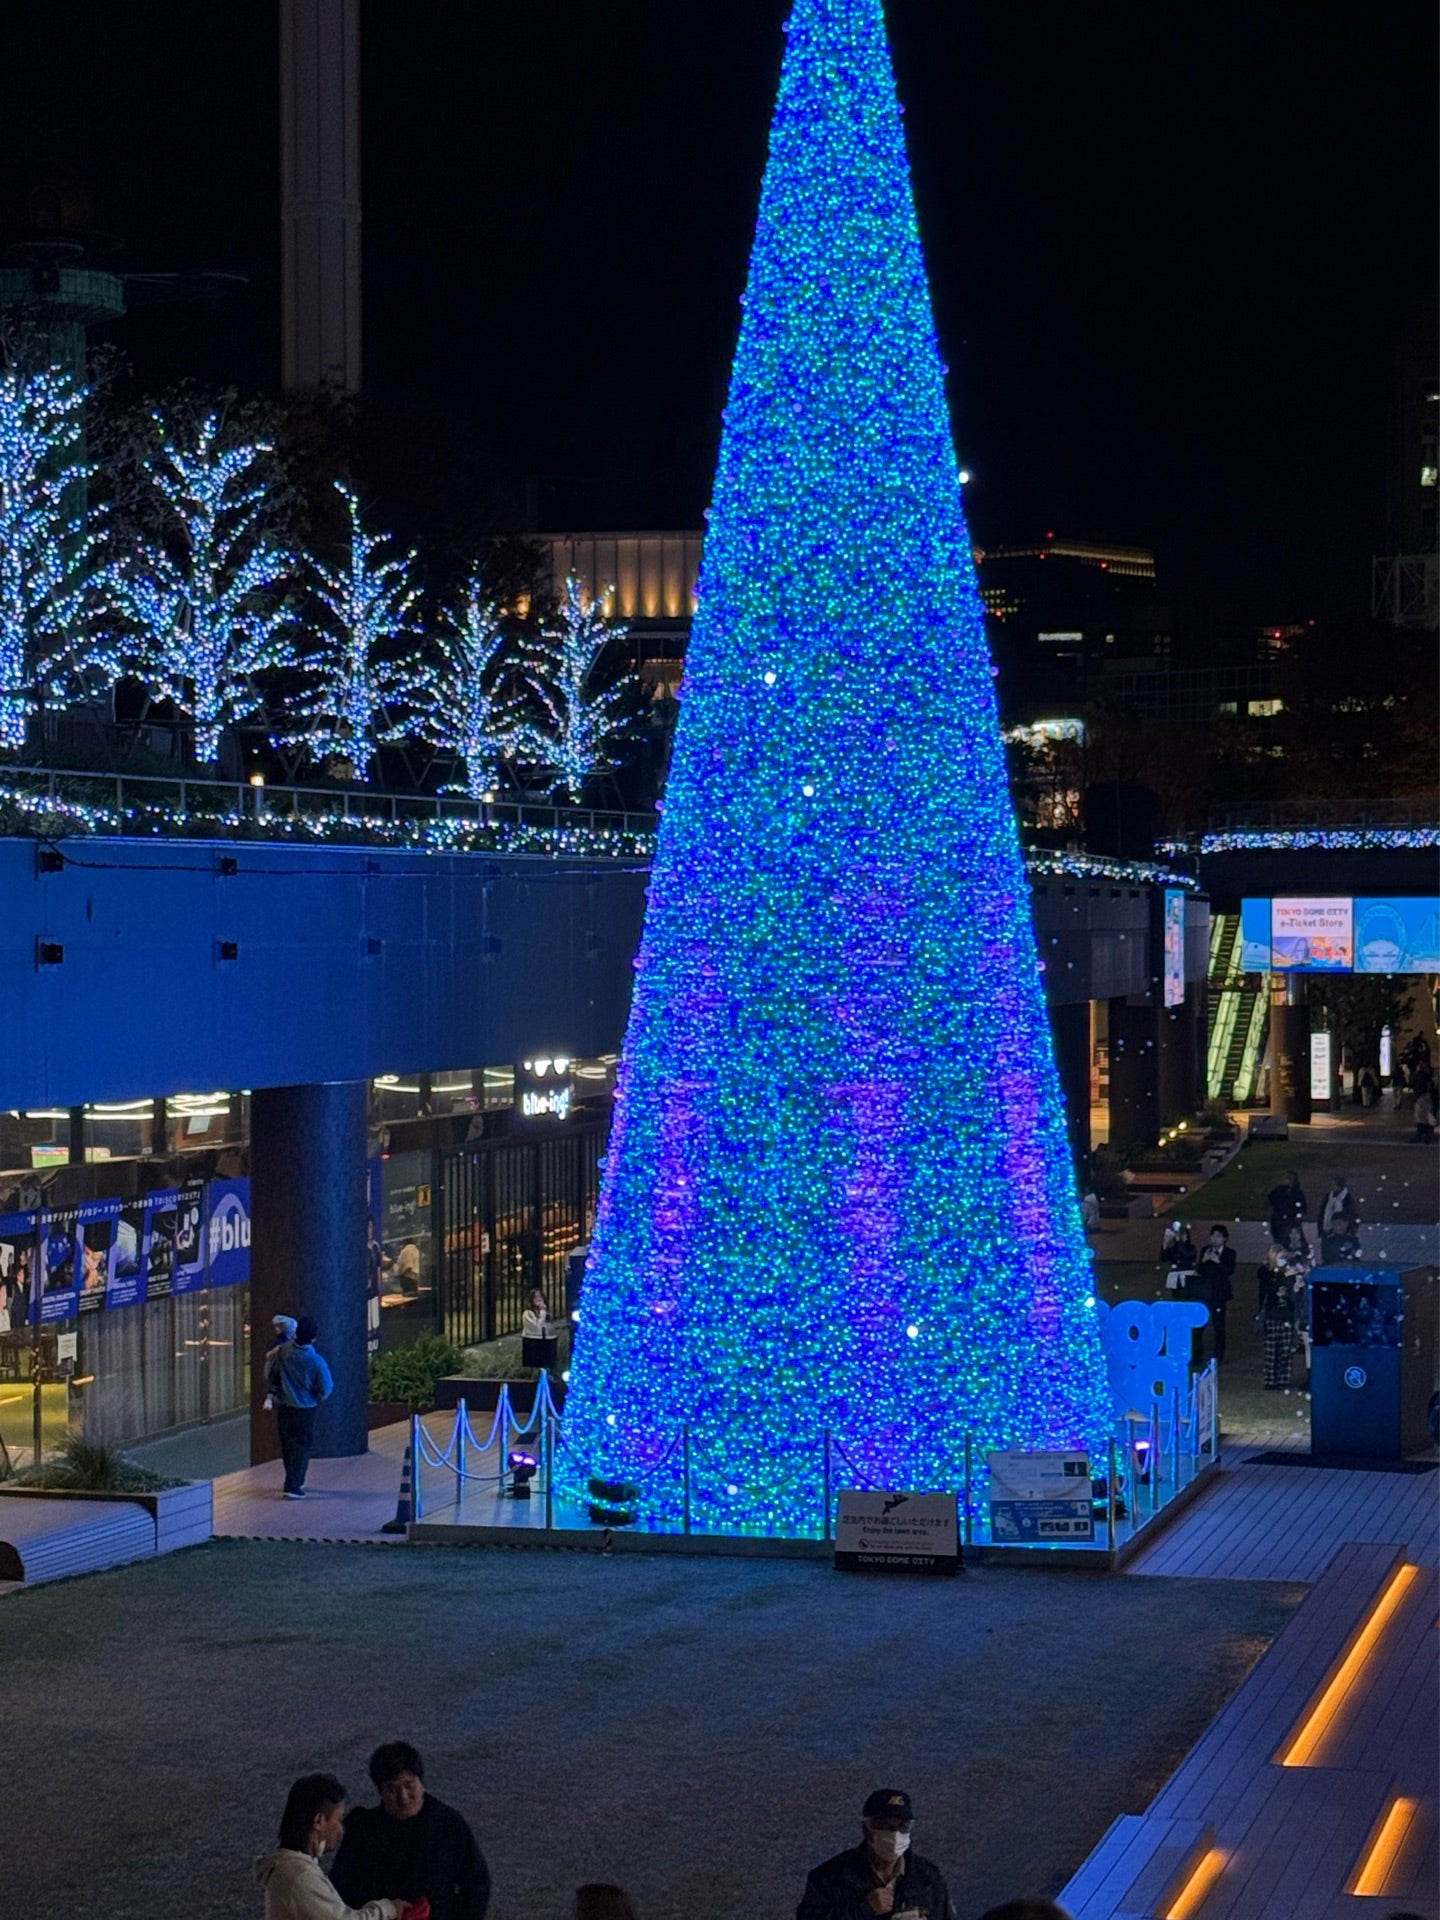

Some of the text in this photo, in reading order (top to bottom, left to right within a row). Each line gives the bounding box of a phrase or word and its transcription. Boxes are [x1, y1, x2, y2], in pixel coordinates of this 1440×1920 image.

[1276, 908, 1349, 916] TOKYO DOME CITY
[1280, 918, 1344, 927] e-Ticket Store
[523, 1088, 569, 1120] blue-ing!
[862, 1526, 881, 1535] Enjoy
[858, 1555, 935, 1565] TOKYO DOME CITY
